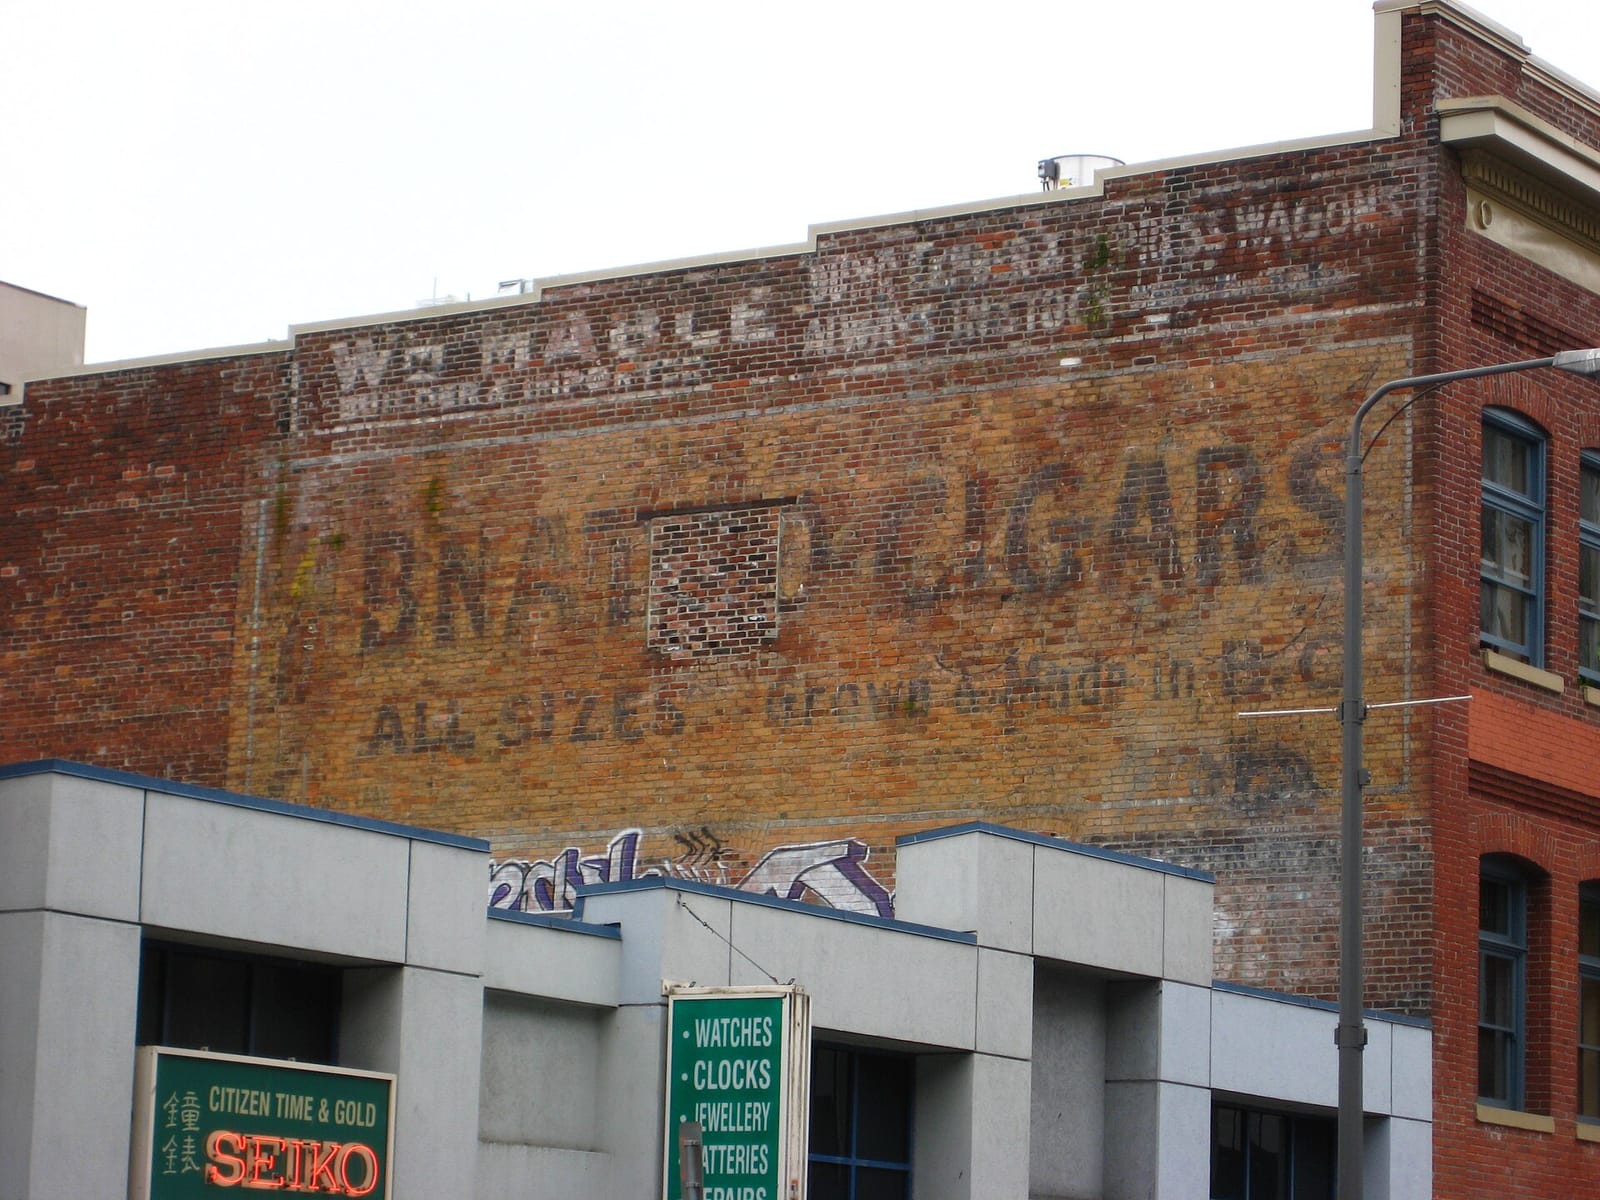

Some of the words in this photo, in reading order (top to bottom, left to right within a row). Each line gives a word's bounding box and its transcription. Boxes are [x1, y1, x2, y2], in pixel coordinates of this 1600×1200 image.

[695, 1016, 773, 1048] WATCHES
[693, 1058, 771, 1090] CLOCKS
[209, 1085, 270, 1117] CITIZEN
[275, 1092, 313, 1121] TIME
[318, 1097, 330, 1123] &
[334, 1099, 376, 1128] GOLD
[204, 1129, 380, 1198] SEIKO
[702, 1143, 769, 1175] ATTERIES
